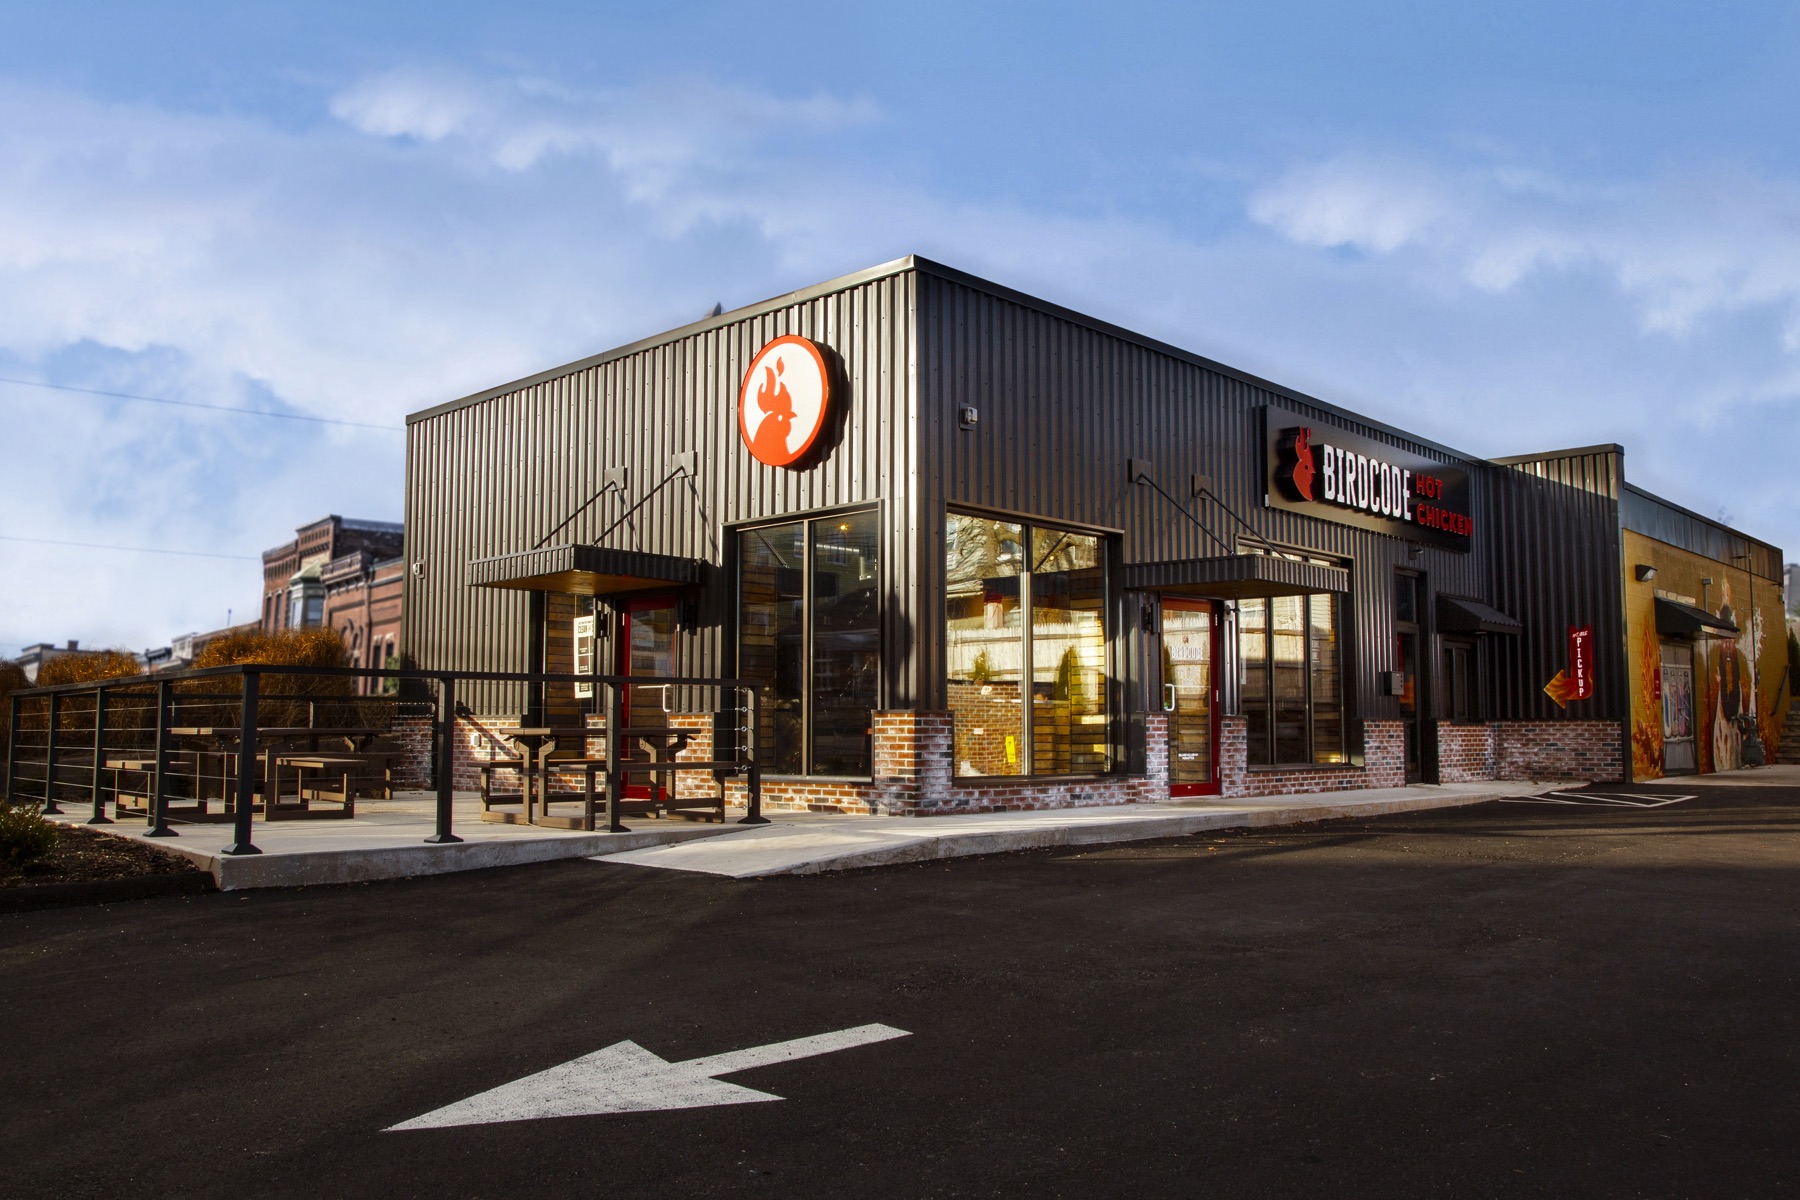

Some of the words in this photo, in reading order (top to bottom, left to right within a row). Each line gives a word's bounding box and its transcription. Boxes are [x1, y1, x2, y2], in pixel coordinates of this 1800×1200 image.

[1323, 443, 1412, 521] BIRDCODE
[1416, 473, 1443, 500] HOT
[1416, 503, 1473, 537] CHICKEN
